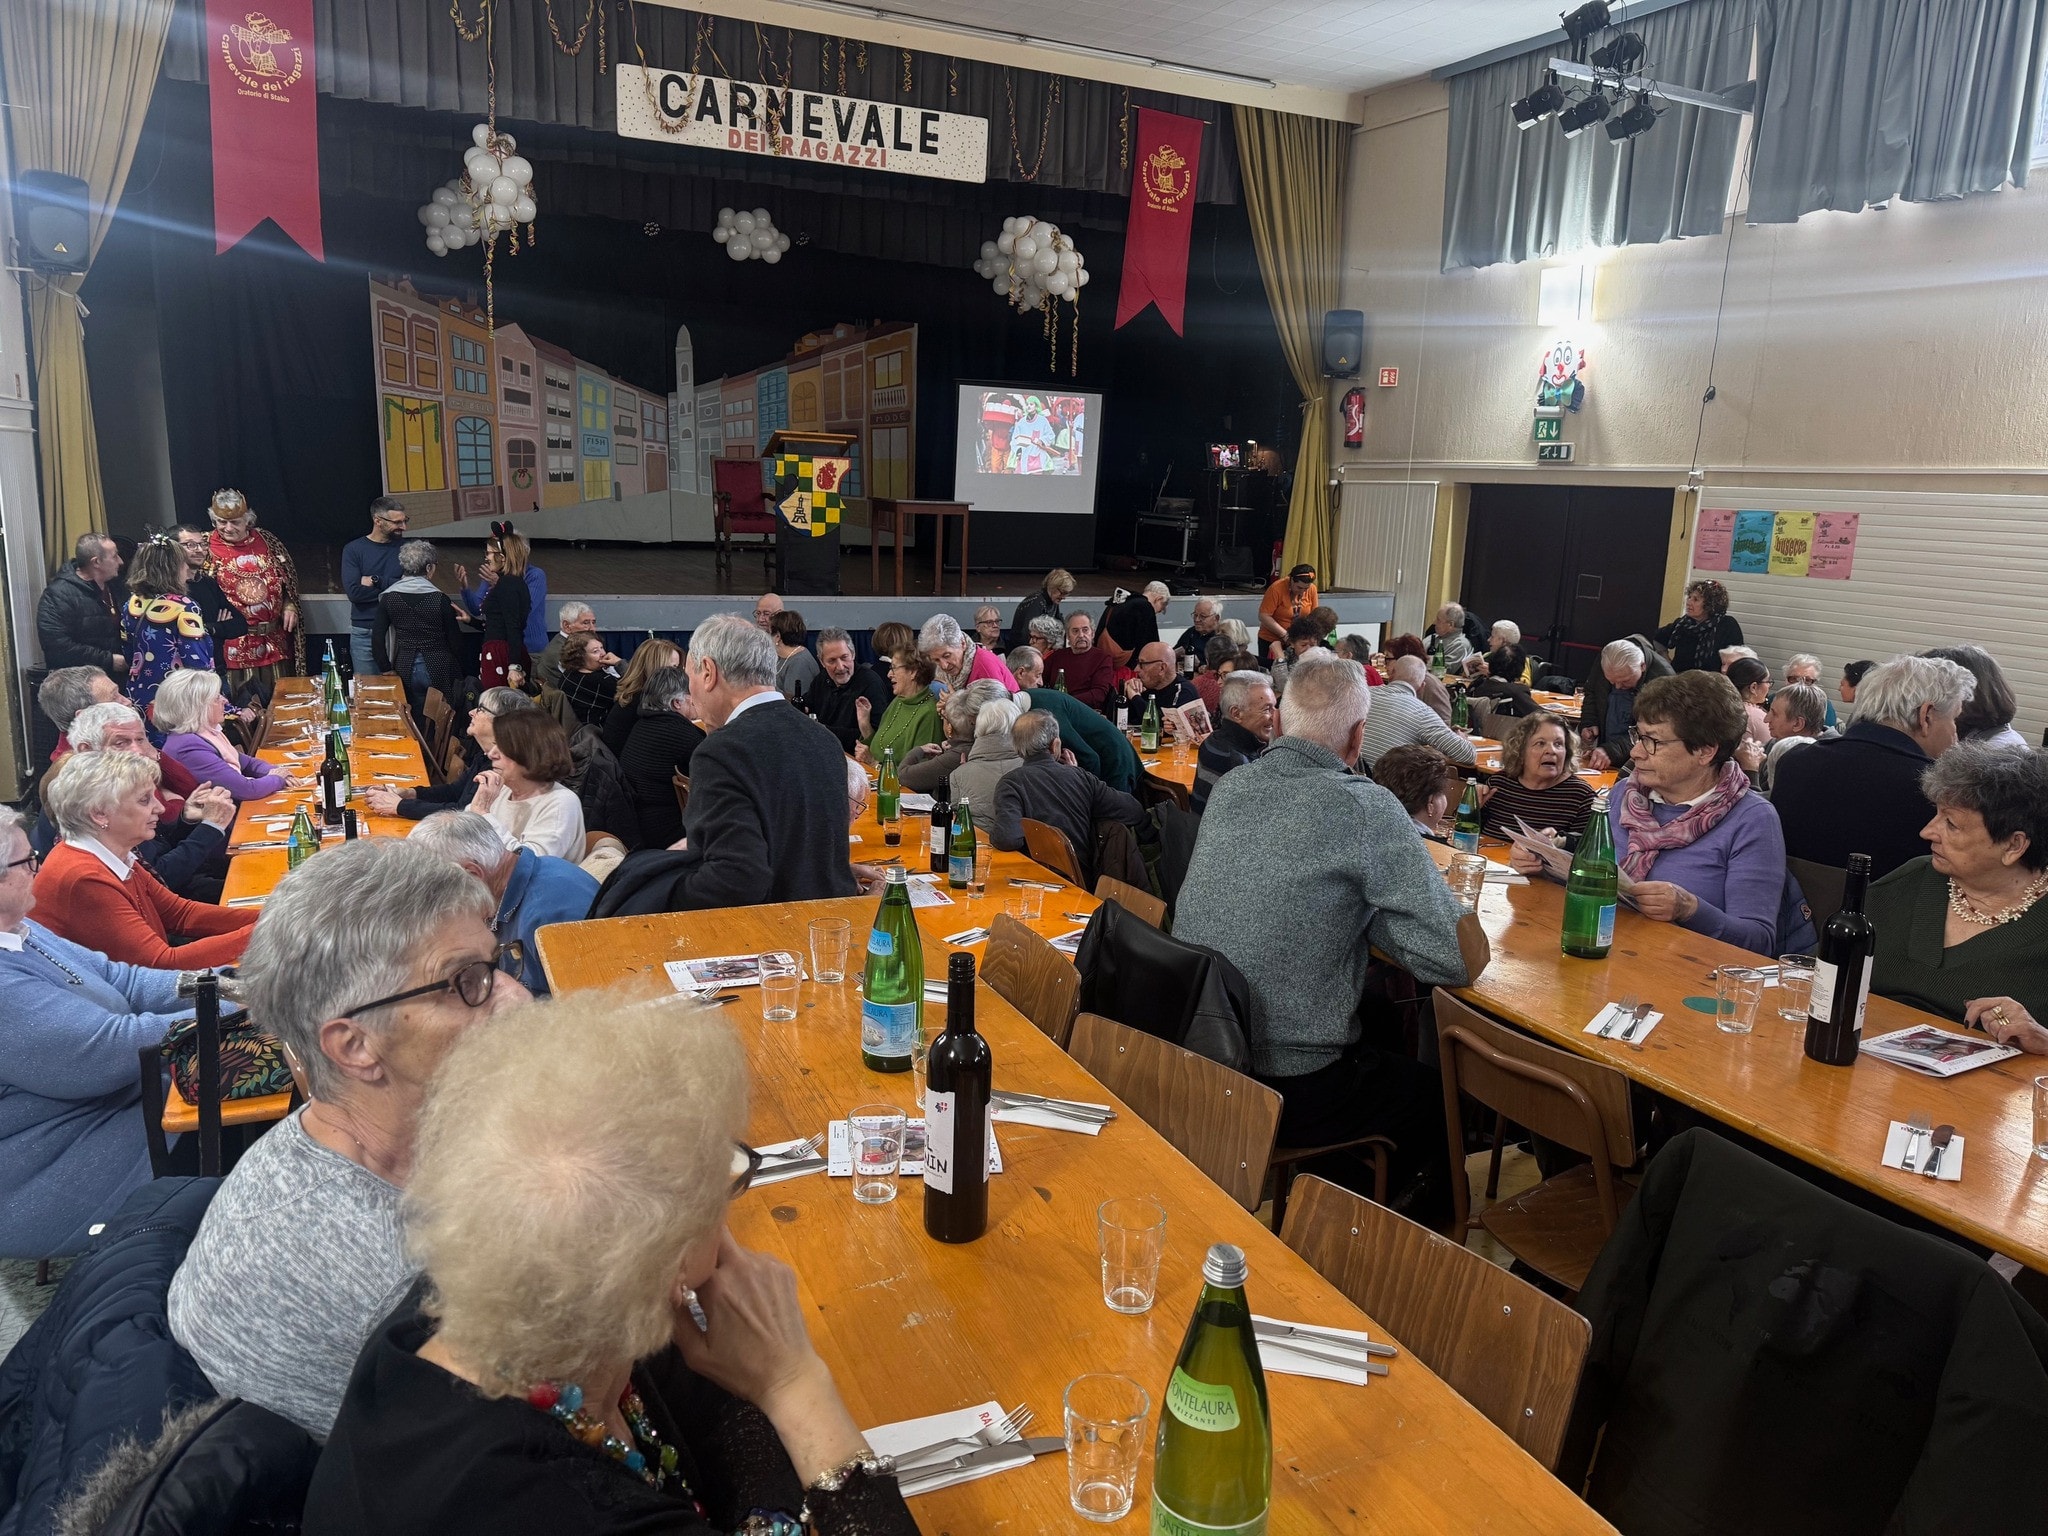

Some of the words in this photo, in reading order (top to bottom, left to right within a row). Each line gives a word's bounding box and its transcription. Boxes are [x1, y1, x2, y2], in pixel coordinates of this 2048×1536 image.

[221, 33, 258, 89] carnevale
[262, 81, 282, 92] dei
[283, 47, 303, 88] ragazzi
[237, 88, 262, 98] Oratorio
[263, 91, 270, 99] di
[270, 93, 290, 103] Stabio
[659, 73, 940, 155] CARNEVALE
[727, 129, 766, 153] DEI
[780, 138, 887, 168] RAGAZZI
[586, 437, 606, 446] FISH
[1170, 1378, 1234, 1416] FONTELAURA
[1173, 1402, 1216, 1426] FRIZZANTE
